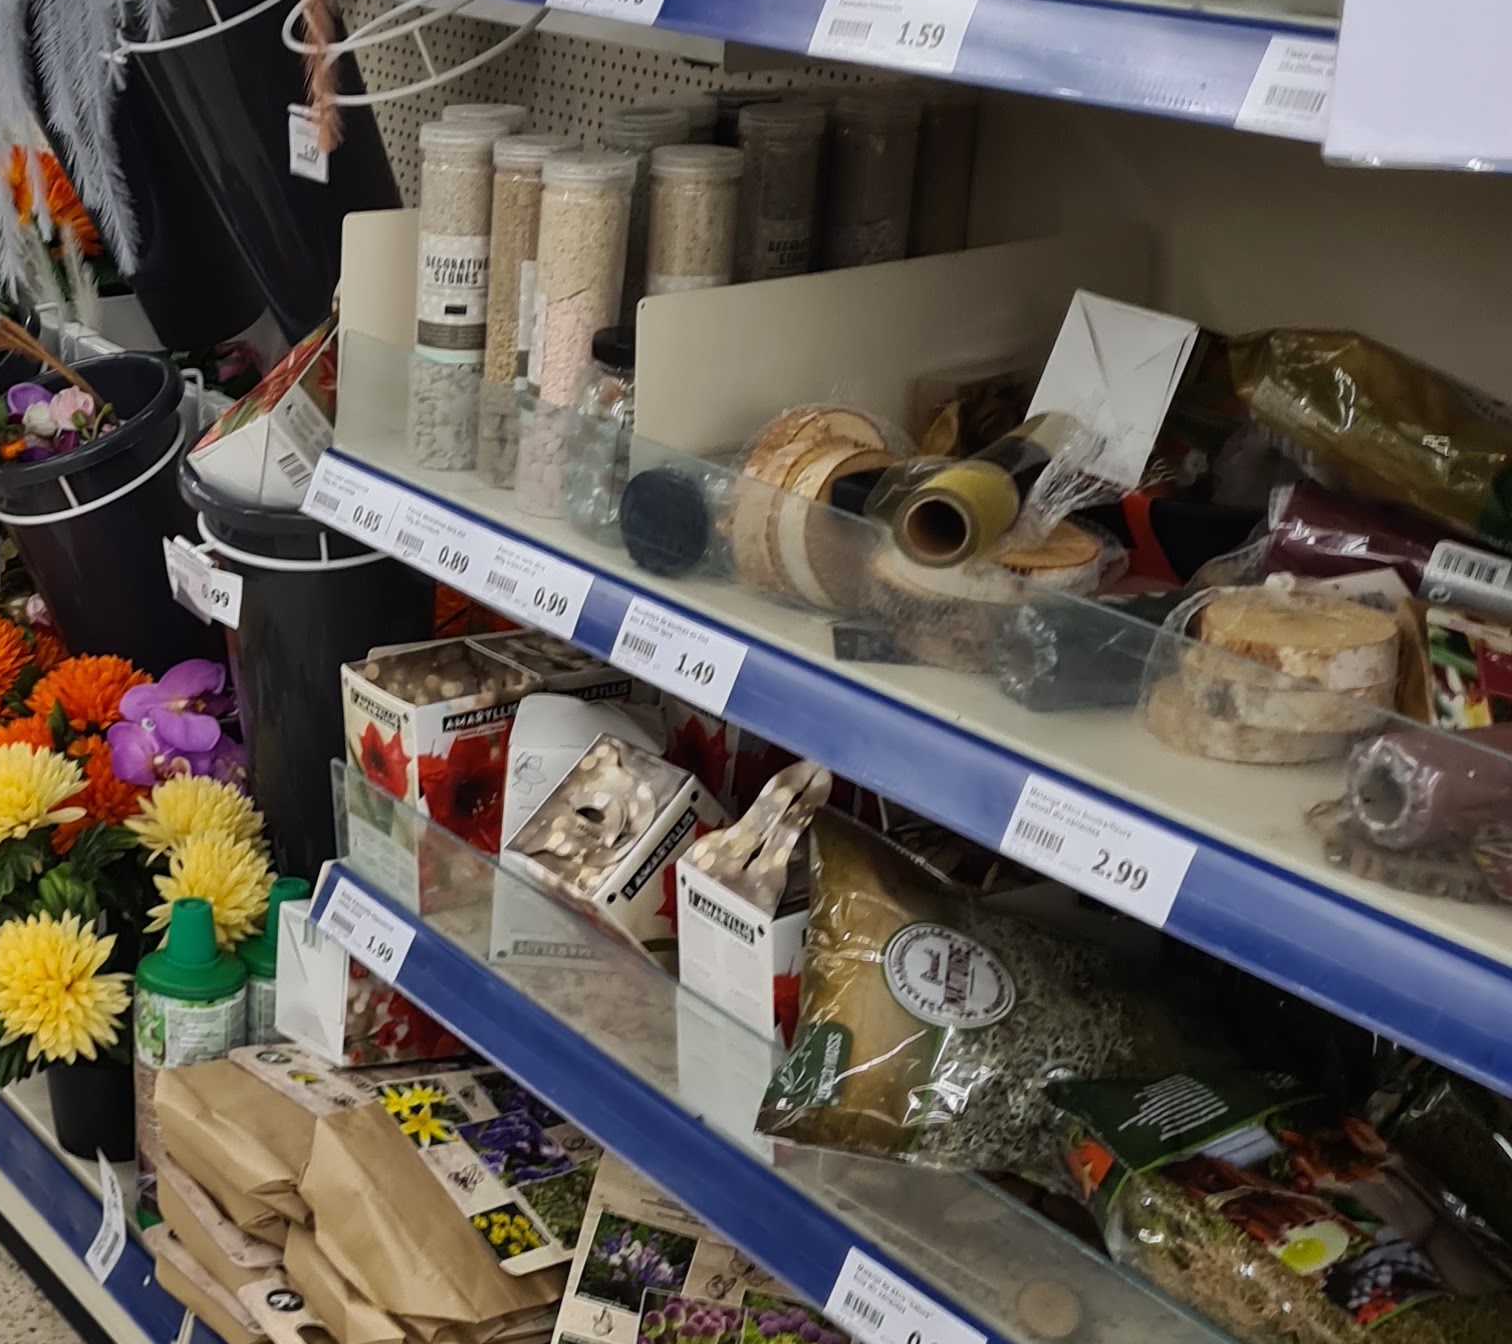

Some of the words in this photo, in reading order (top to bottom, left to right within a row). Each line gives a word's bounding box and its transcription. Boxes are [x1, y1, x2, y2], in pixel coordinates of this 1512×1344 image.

[896, 21, 946, 49] 1.59
[352, 505, 383, 533] 0.85
[438, 545, 470, 575] 0.89
[534, 586, 568, 616] 0.99
[675, 652, 716, 686] 1.49
[1091, 848, 1149, 893] 2.99
[366, 936, 394, 963] 1.99
